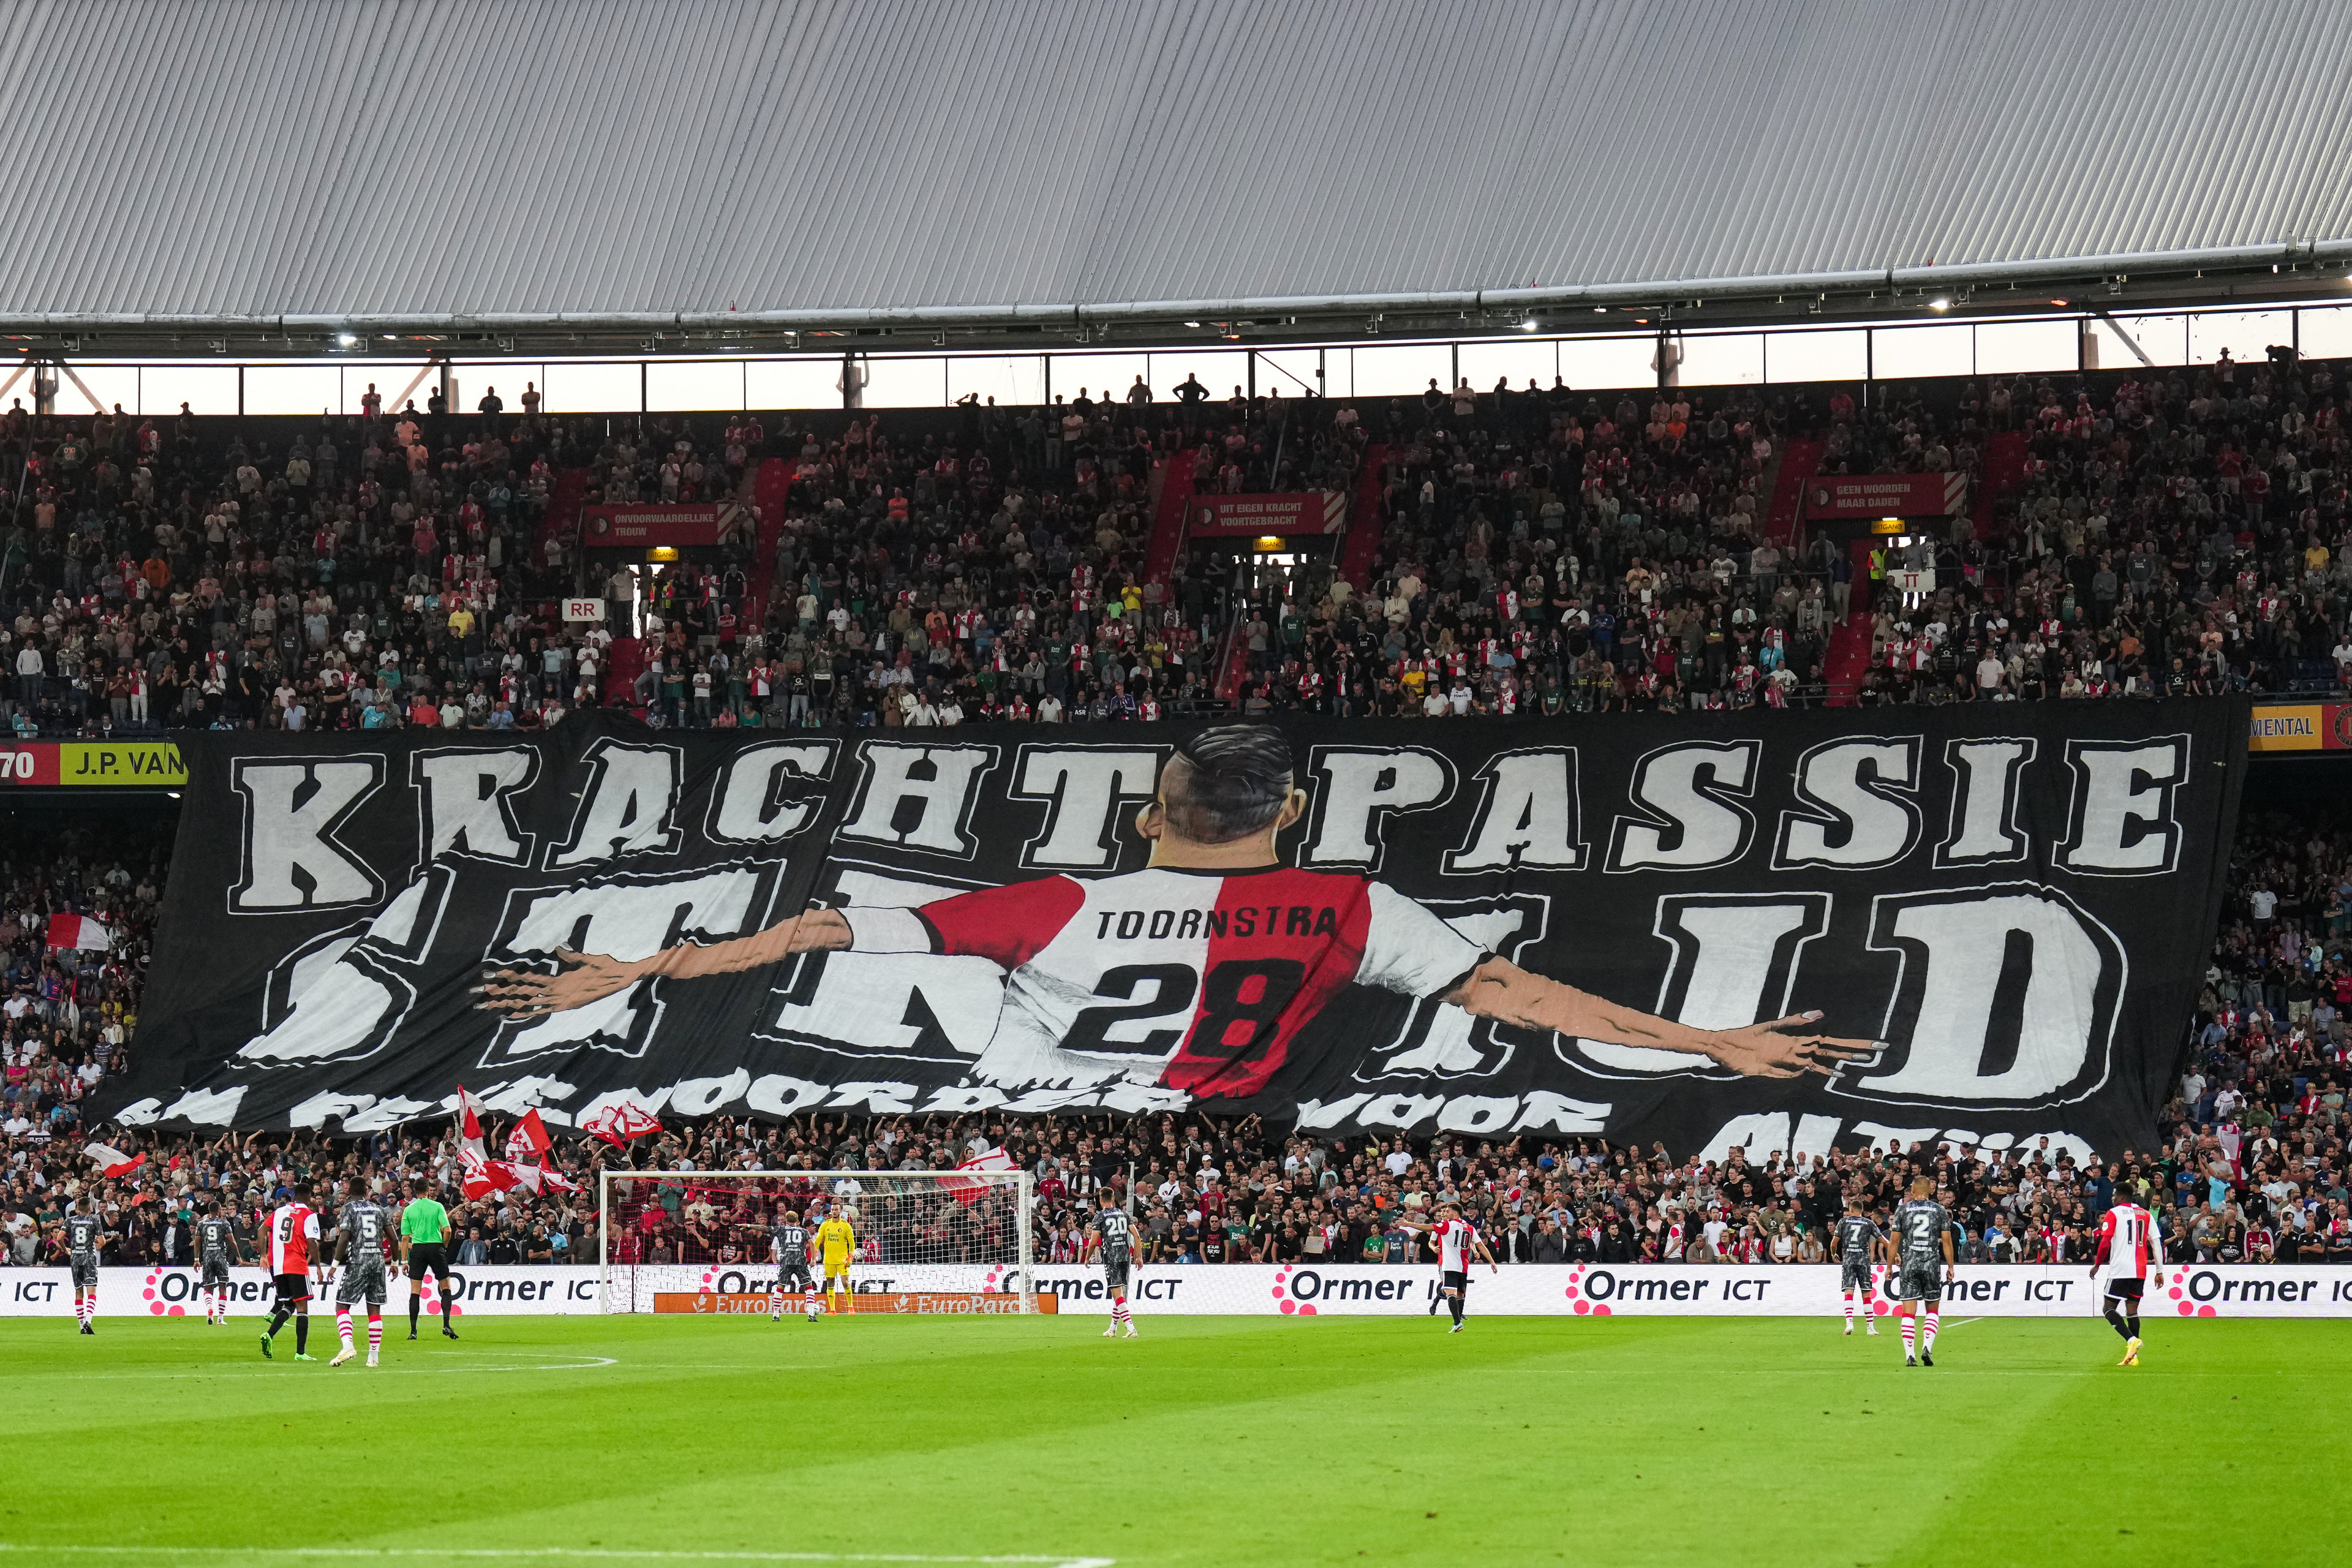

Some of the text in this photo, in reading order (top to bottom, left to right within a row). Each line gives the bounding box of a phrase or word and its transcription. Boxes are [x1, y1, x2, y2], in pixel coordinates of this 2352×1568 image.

[1837, 483, 1910, 494] GEEN WOORDEN
[1220, 502, 1303, 513] UIT EIGEN KRACHT
[1837, 497, 1901, 508] MAAR DADEN
[615, 513, 714, 524] ONVOORWAARDELIJKE
[1220, 516, 1297, 526] VOORTGEBRACHT
[615, 527, 647, 537] TROUW
[1904, 574, 1918, 587] TT
[570, 602, 596, 617] RR
[75, 752, 184, 775] J.P. VAN
[228, 733, 2191, 914] KRACHT PASSIE
[1096, 905, 1336, 940] TOORNSTRA
[1058, 959, 1305, 1058] 28
[1294, 1090, 1612, 1133] VOOR
[75, 1227, 86, 1243] 8
[206, 1226, 217, 1241] 9
[279, 1216, 295, 1243] 9
[361, 1215, 377, 1238] 5
[1105, 1217, 1128, 1235] 20
[1850, 1225, 1861, 1242] 7
[1913, 1214, 1930, 1237] 2
[2127, 1219, 2144, 1246] 11
[786, 1230, 802, 1243] 10
[1454, 1229, 1471, 1250] 10
[15, 1281, 58, 1302] ICT
[439, 1272, 553, 1300] Ormer
[1136, 1280, 1183, 1300] ICT
[1291, 1271, 1412, 1300] Ormer
[1585, 1270, 1771, 1300] Ormer ICT
[1884, 1272, 2074, 1301] Omer ICT
[2188, 1271, 2318, 1302] Ormer
